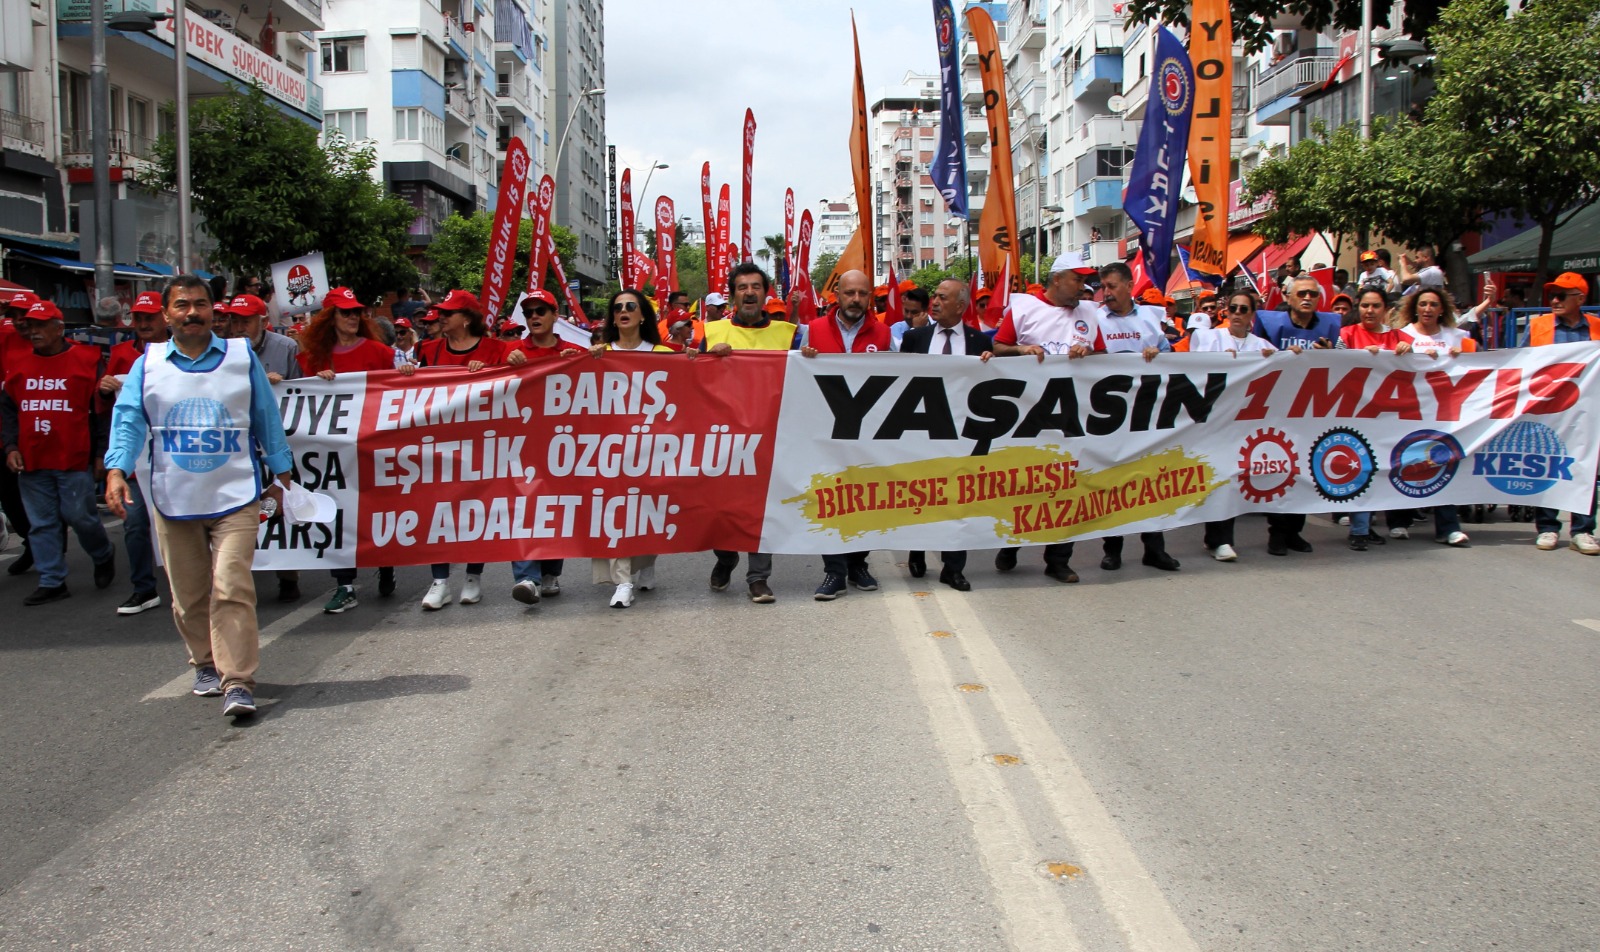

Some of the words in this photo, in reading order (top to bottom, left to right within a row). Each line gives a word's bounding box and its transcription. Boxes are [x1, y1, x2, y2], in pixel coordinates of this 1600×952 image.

[166, 7, 224, 59] ZYBEK
[232, 43, 274, 86] SÜRÜCÜ
[276, 69, 306, 103] KURSU
[490, 217, 513, 289] SAĞLIK
[485, 291, 501, 328] DEV
[1106, 331, 1141, 341] KAMU-İŞ
[25, 378, 68, 391] DİSK
[375, 378, 533, 431] EKMEK,
[543, 370, 677, 424] BARIŞ,
[1235, 369, 1284, 421] 1
[1286, 362, 1587, 422] MAYIS
[21, 399, 73, 413] GENEL
[34, 416, 52, 436] İŞ
[280, 388, 355, 436] ÜYE
[813, 372, 1228, 456] YAŞASIN
[160, 429, 242, 453] KESK
[374, 429, 537, 494] EŞİTLİK,
[547, 424, 763, 478] ÖZGÜRLÜK
[187, 459, 213, 470] 1995
[1252, 452, 1288, 475] DİSK
[1472, 452, 1576, 481] KESK
[815, 476, 948, 519] BİRLEŞE
[957, 459, 1080, 505] BİRLEŞE
[1012, 464, 1207, 535] KAZANACAĞIZ!
[1326, 483, 1357, 495] 1952
[1506, 480, 1534, 491] 1995
[255, 508, 344, 558] ARŞI
[371, 510, 419, 548] ve
[427, 494, 583, 545] ADALET
[589, 487, 681, 549] İÇİN;
